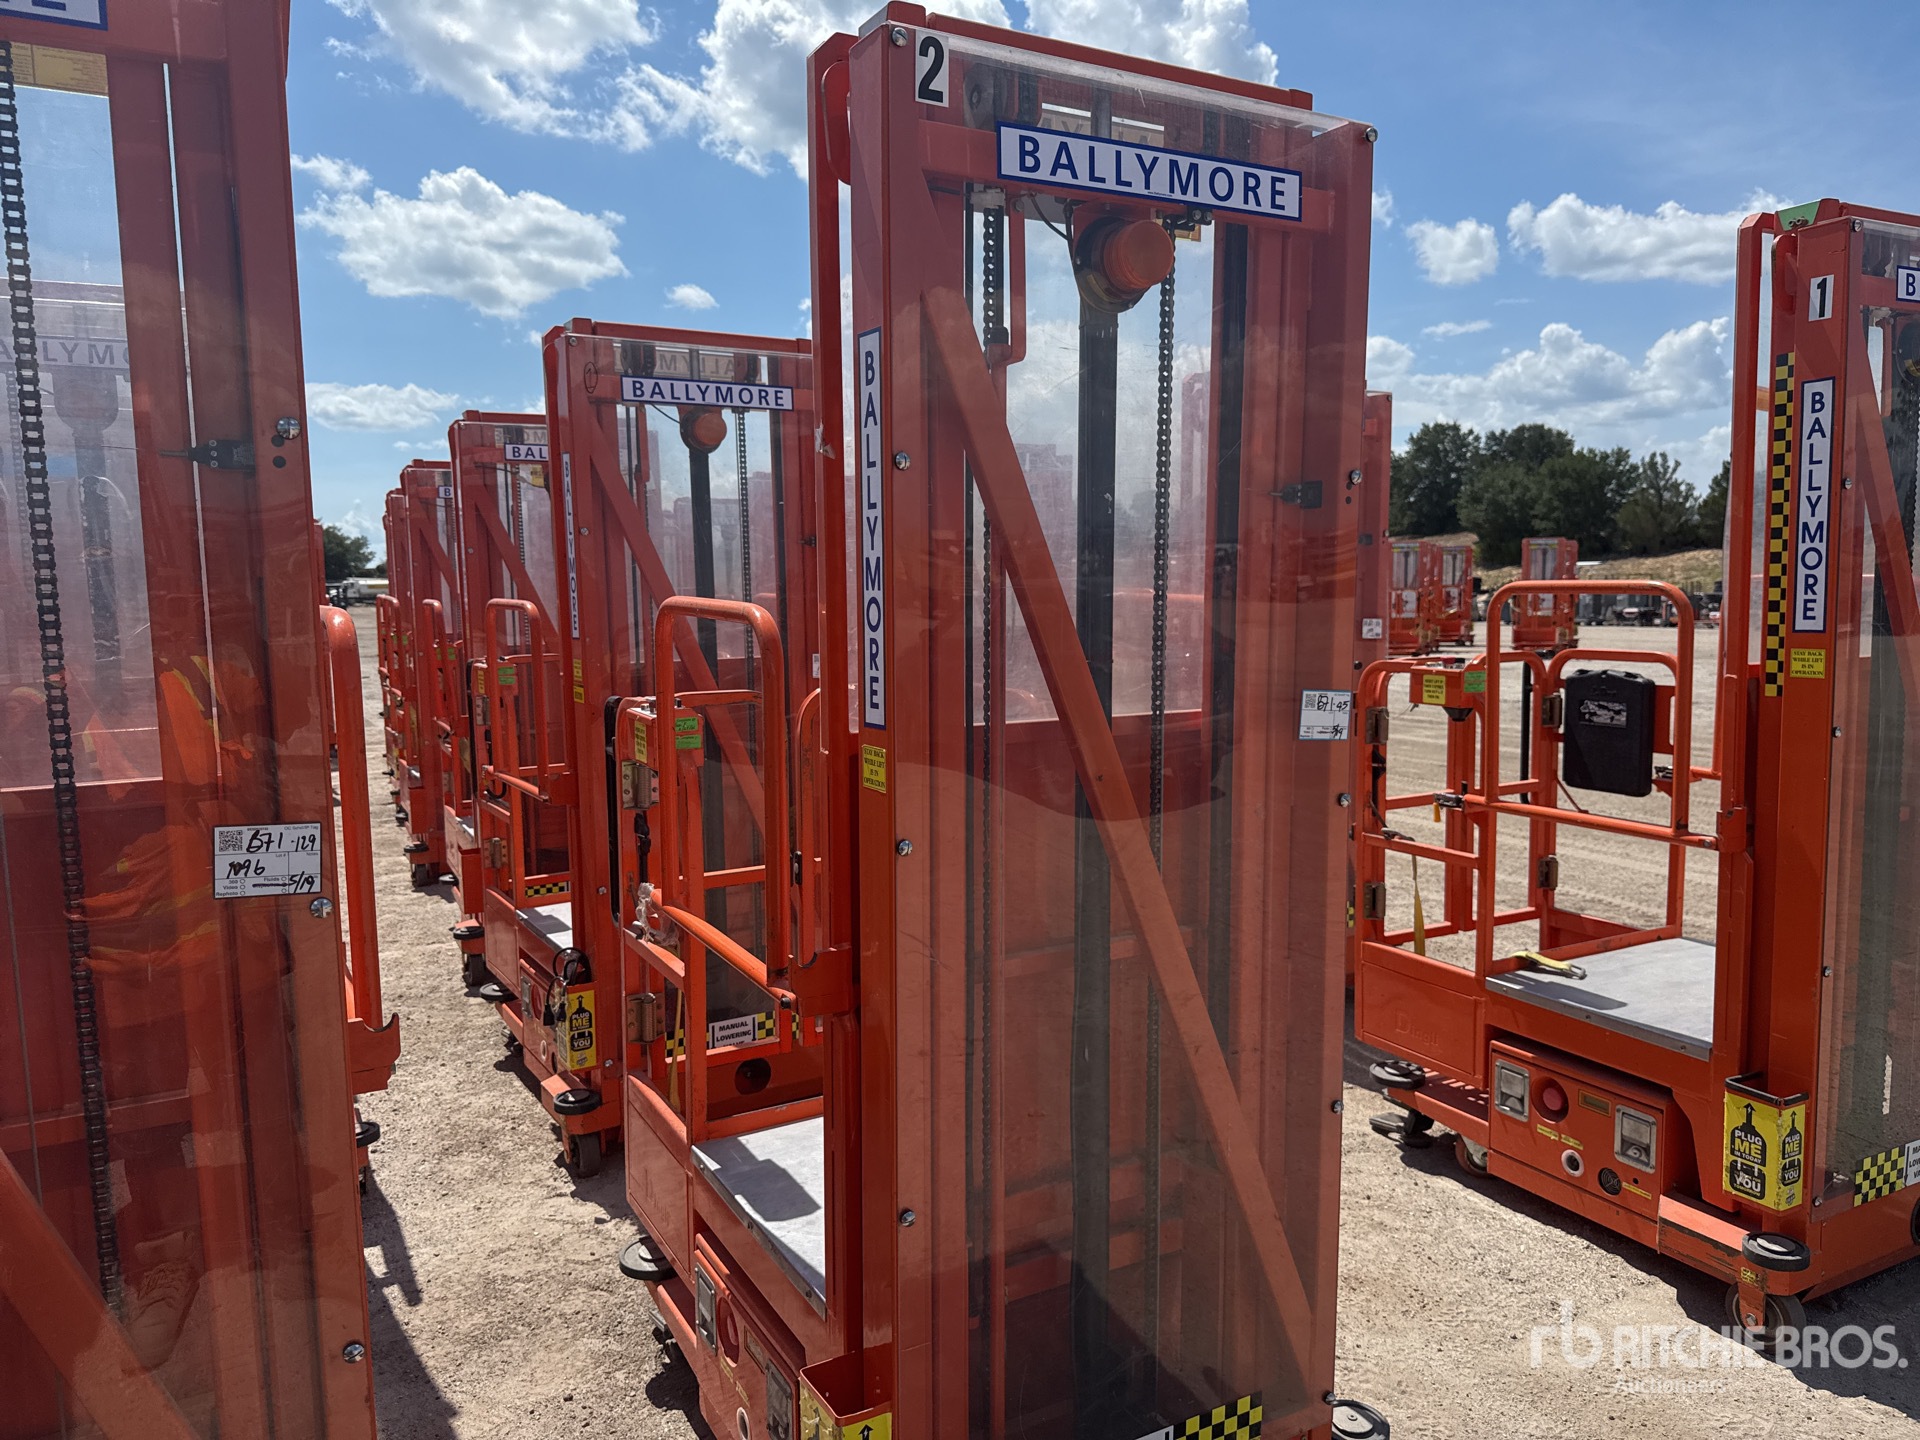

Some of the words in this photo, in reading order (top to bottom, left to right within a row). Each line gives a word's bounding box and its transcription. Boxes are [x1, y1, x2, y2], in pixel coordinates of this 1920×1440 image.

[918, 36, 944, 103] 2
[1018, 134, 1286, 211] BALLYMORE
[1816, 277, 1828, 318] 1
[632, 380, 785, 407] BALLYMORE
[1801, 391, 1827, 620] BALLYMORE
[864, 350, 882, 709] BALLYMORE
[564, 461, 578, 631] BALLYMORE
[572, 1012, 590, 1020] PLUG
[572, 1017, 590, 1028] ME
[719, 1021, 749, 1032] MANUAL
[573, 1038, 591, 1048] YOU
[716, 1029, 752, 1042] LOWERING
[1734, 1129, 1762, 1146] PLUG
[1785, 1133, 1800, 1144] PLUG
[1734, 1137, 1762, 1159] ME
[1785, 1141, 1799, 1153] ME
[1741, 1153, 1761, 1163] TODAY
[1734, 1174, 1761, 1192] YOU
[1784, 1169, 1799, 1180] YOU
